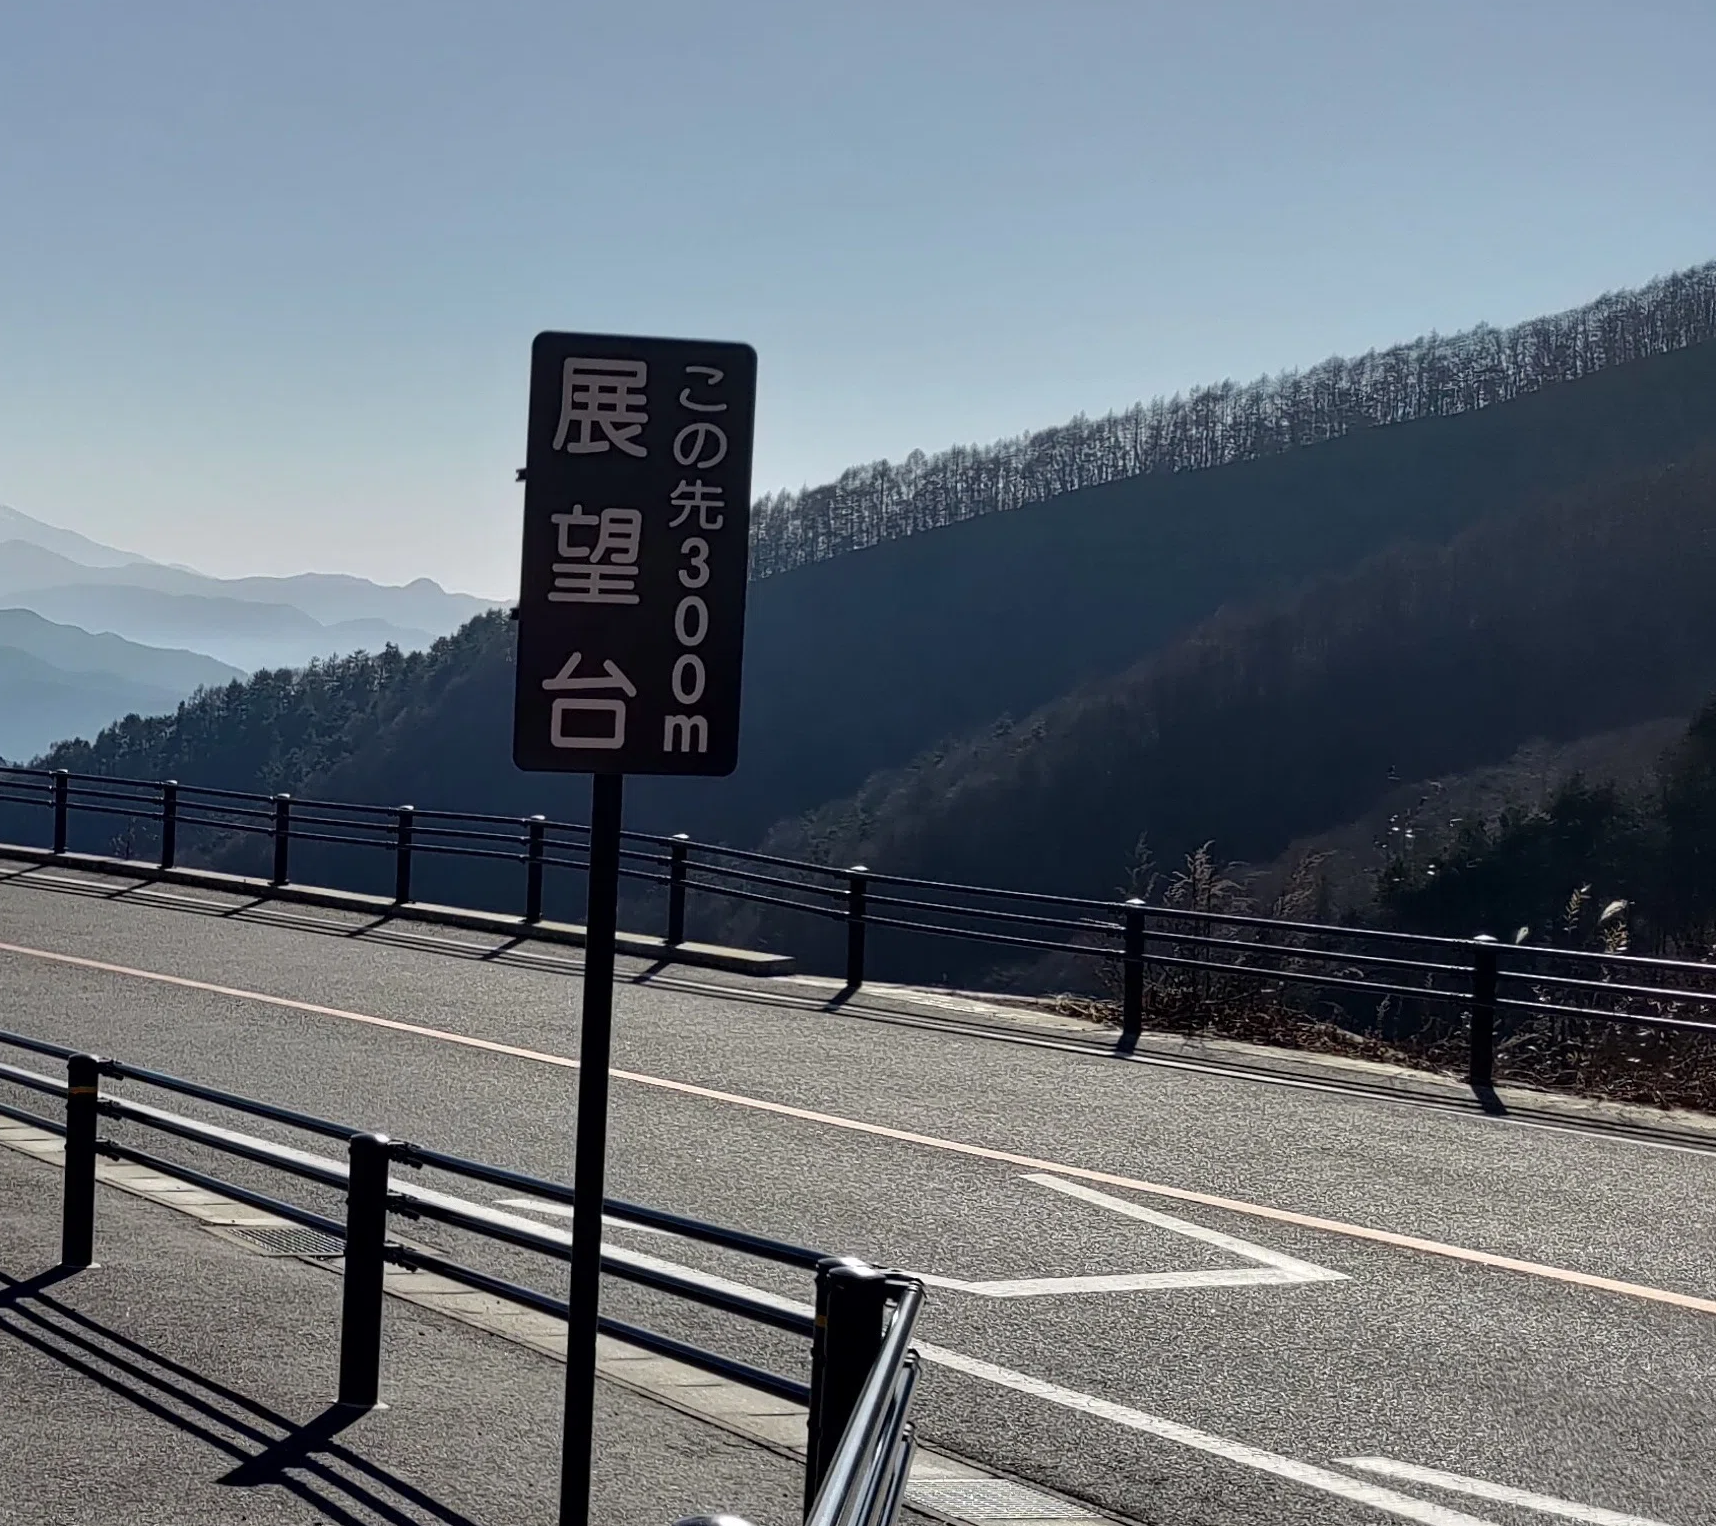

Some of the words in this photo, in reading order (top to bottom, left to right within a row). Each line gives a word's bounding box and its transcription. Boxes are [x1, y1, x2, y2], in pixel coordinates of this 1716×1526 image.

[542, 357, 649, 750] 展望台
[663, 365, 729, 753] この先300m
